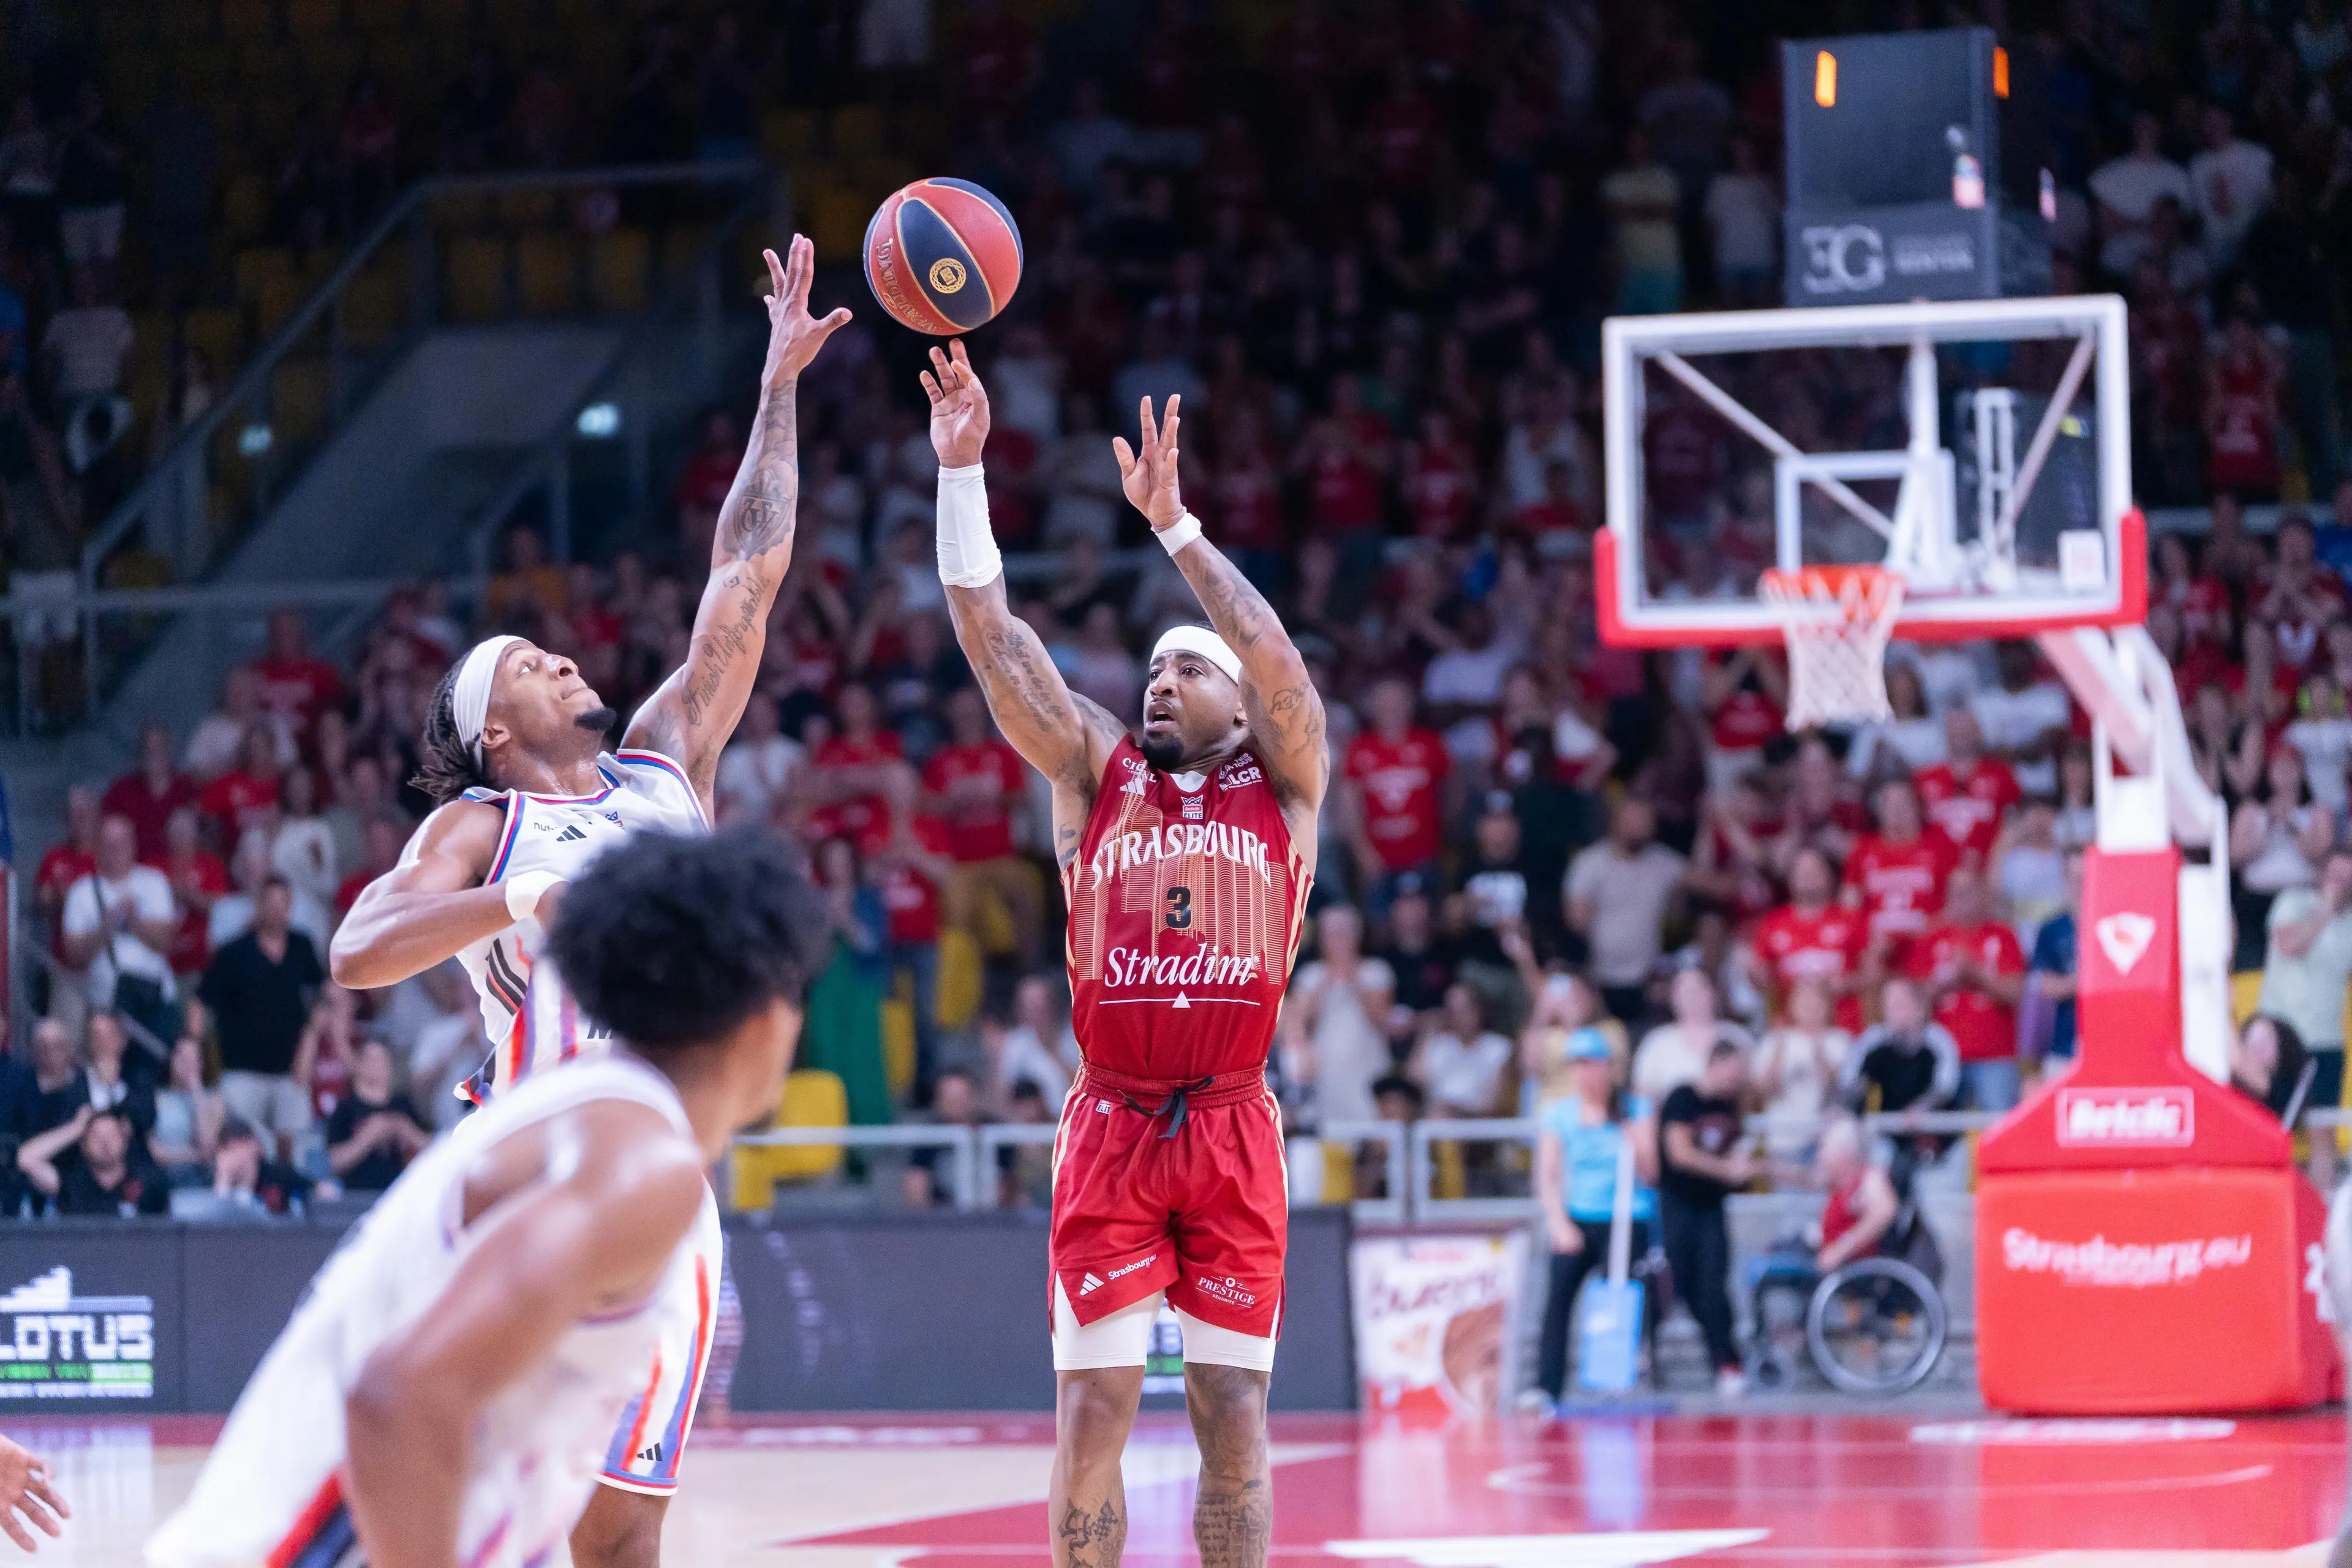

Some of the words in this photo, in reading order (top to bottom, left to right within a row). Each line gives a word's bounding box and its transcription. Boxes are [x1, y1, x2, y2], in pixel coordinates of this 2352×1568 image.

[1228, 766, 1262, 785] LCR
[1091, 820, 1272, 891] STRASBOURG
[1166, 886, 1192, 929] 3
[1104, 942, 1254, 987] Stradim
[1108, 1254, 1156, 1280] Strasbourg.eu
[1198, 1276, 1256, 1305] PRESTIGE
[1212, 1294, 1235, 1305] SÉCURITÉ
